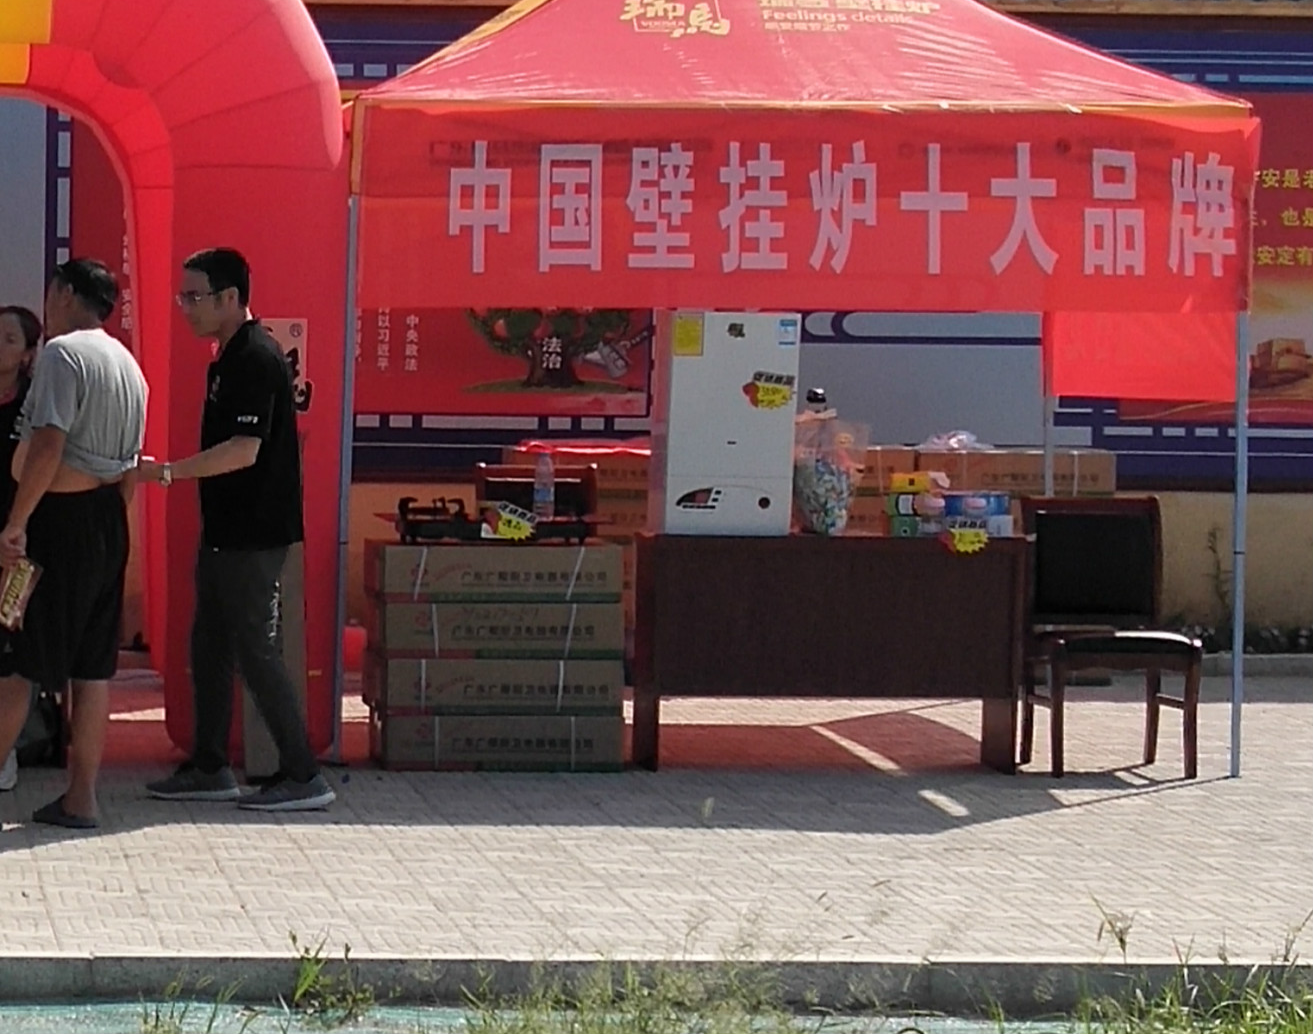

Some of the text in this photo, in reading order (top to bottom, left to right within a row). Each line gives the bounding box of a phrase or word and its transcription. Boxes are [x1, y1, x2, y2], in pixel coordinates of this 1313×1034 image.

[762, 9, 847, 24] Feelings
[1254, 168, 1313, 189] 安是老
[447, 140, 1238, 277] 中国壁挂炉十大品牌
[1252, 246, 1313, 266] 安定有
[405, 314, 419, 371] 中央政法
[542, 336, 563, 370] 法治
